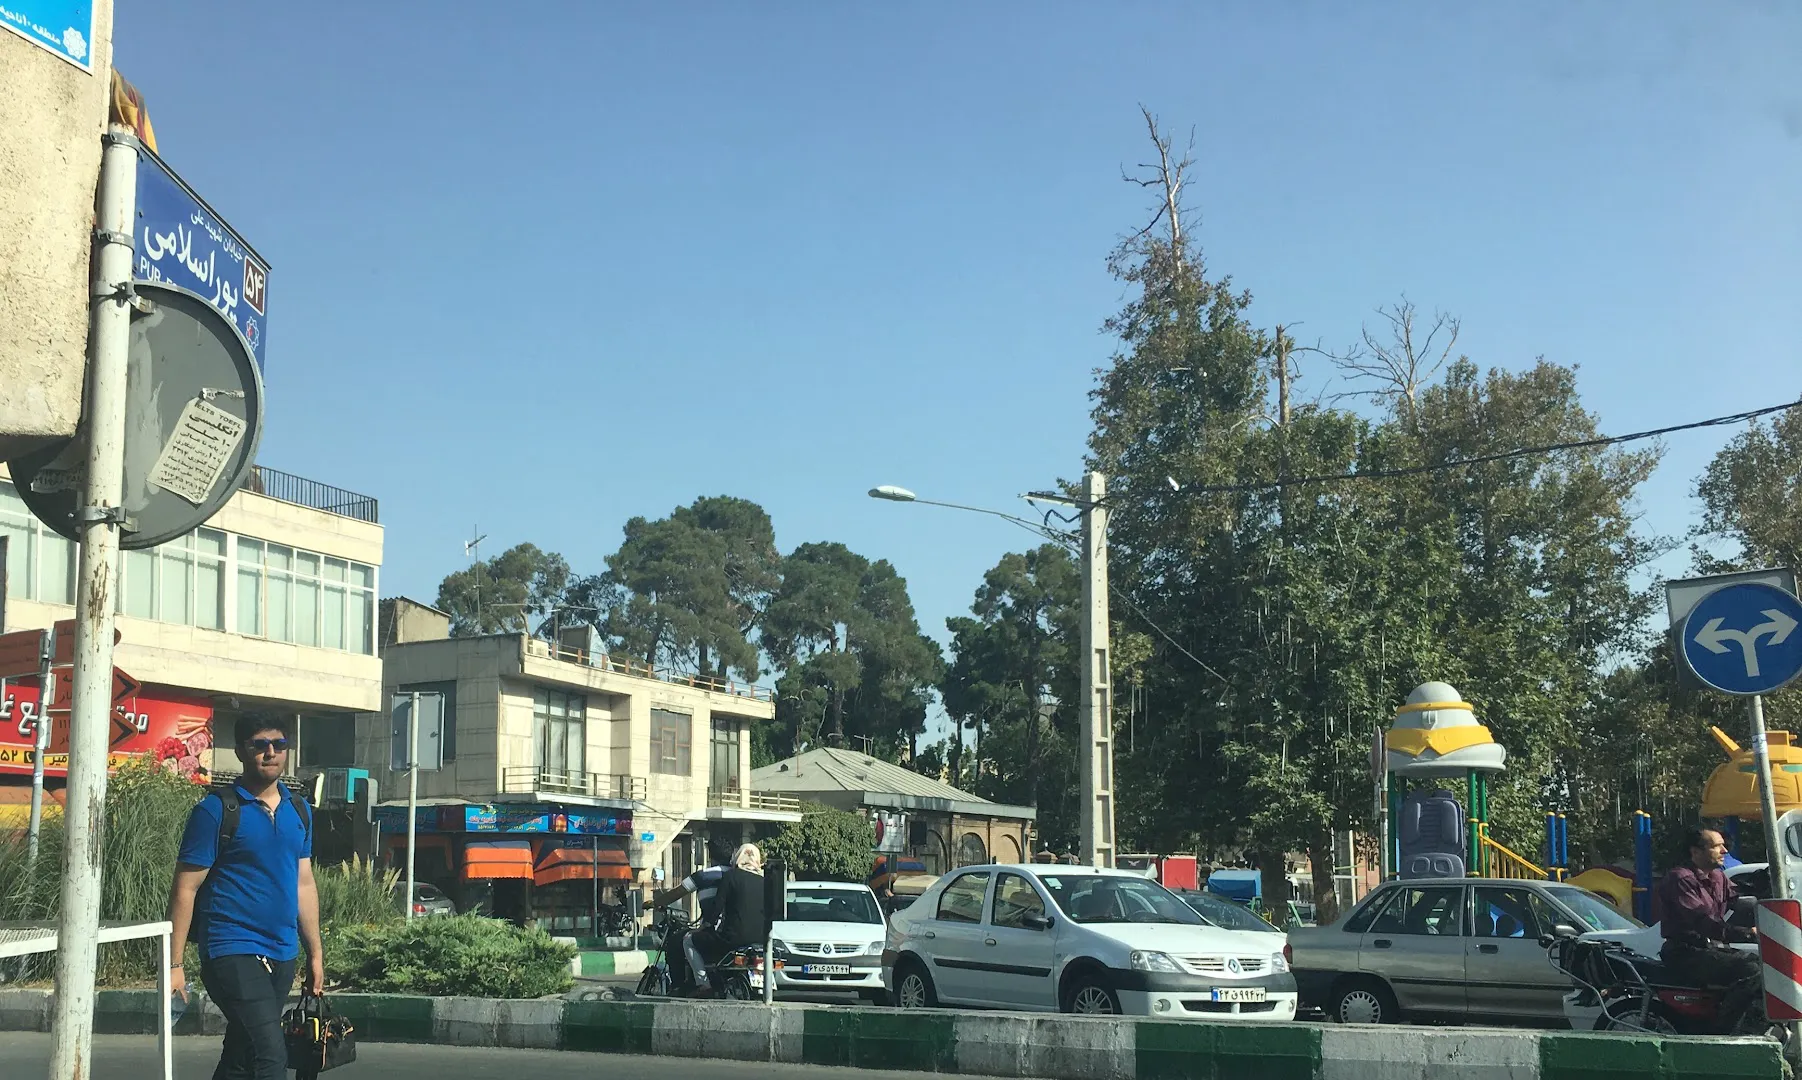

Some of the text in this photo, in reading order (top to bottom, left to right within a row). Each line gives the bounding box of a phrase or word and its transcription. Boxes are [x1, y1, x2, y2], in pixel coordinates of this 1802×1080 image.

[190, 209, 243, 263] خیابان شهید علی
[140, 255, 161, 282] PUR
[245, 265, 263, 304] ۵۴
[194, 402, 241, 429] IELTS TOEFL
